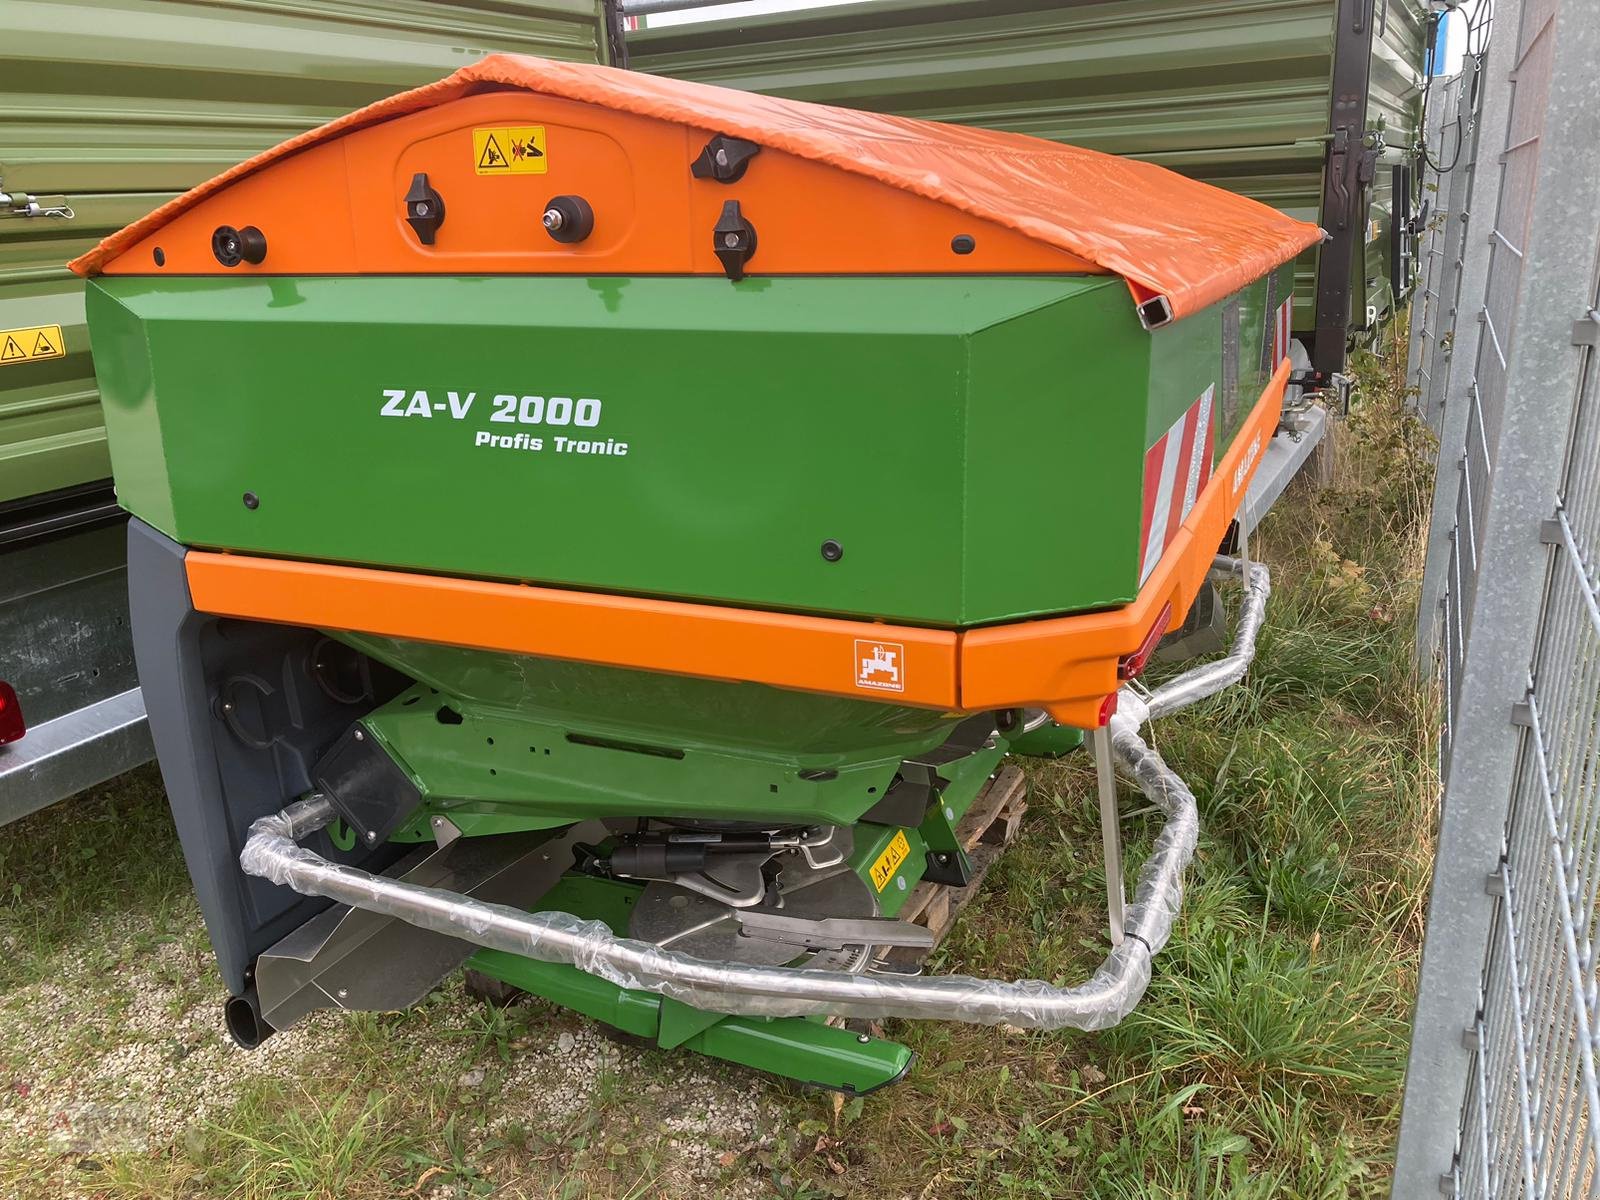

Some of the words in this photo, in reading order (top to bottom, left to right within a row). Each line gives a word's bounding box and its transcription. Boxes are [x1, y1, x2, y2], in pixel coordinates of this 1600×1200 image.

[380, 389, 476, 419] ZA-V
[490, 394, 602, 427] 2000
[475, 431, 543, 451] Profis
[553, 436, 628, 456] Tronic
